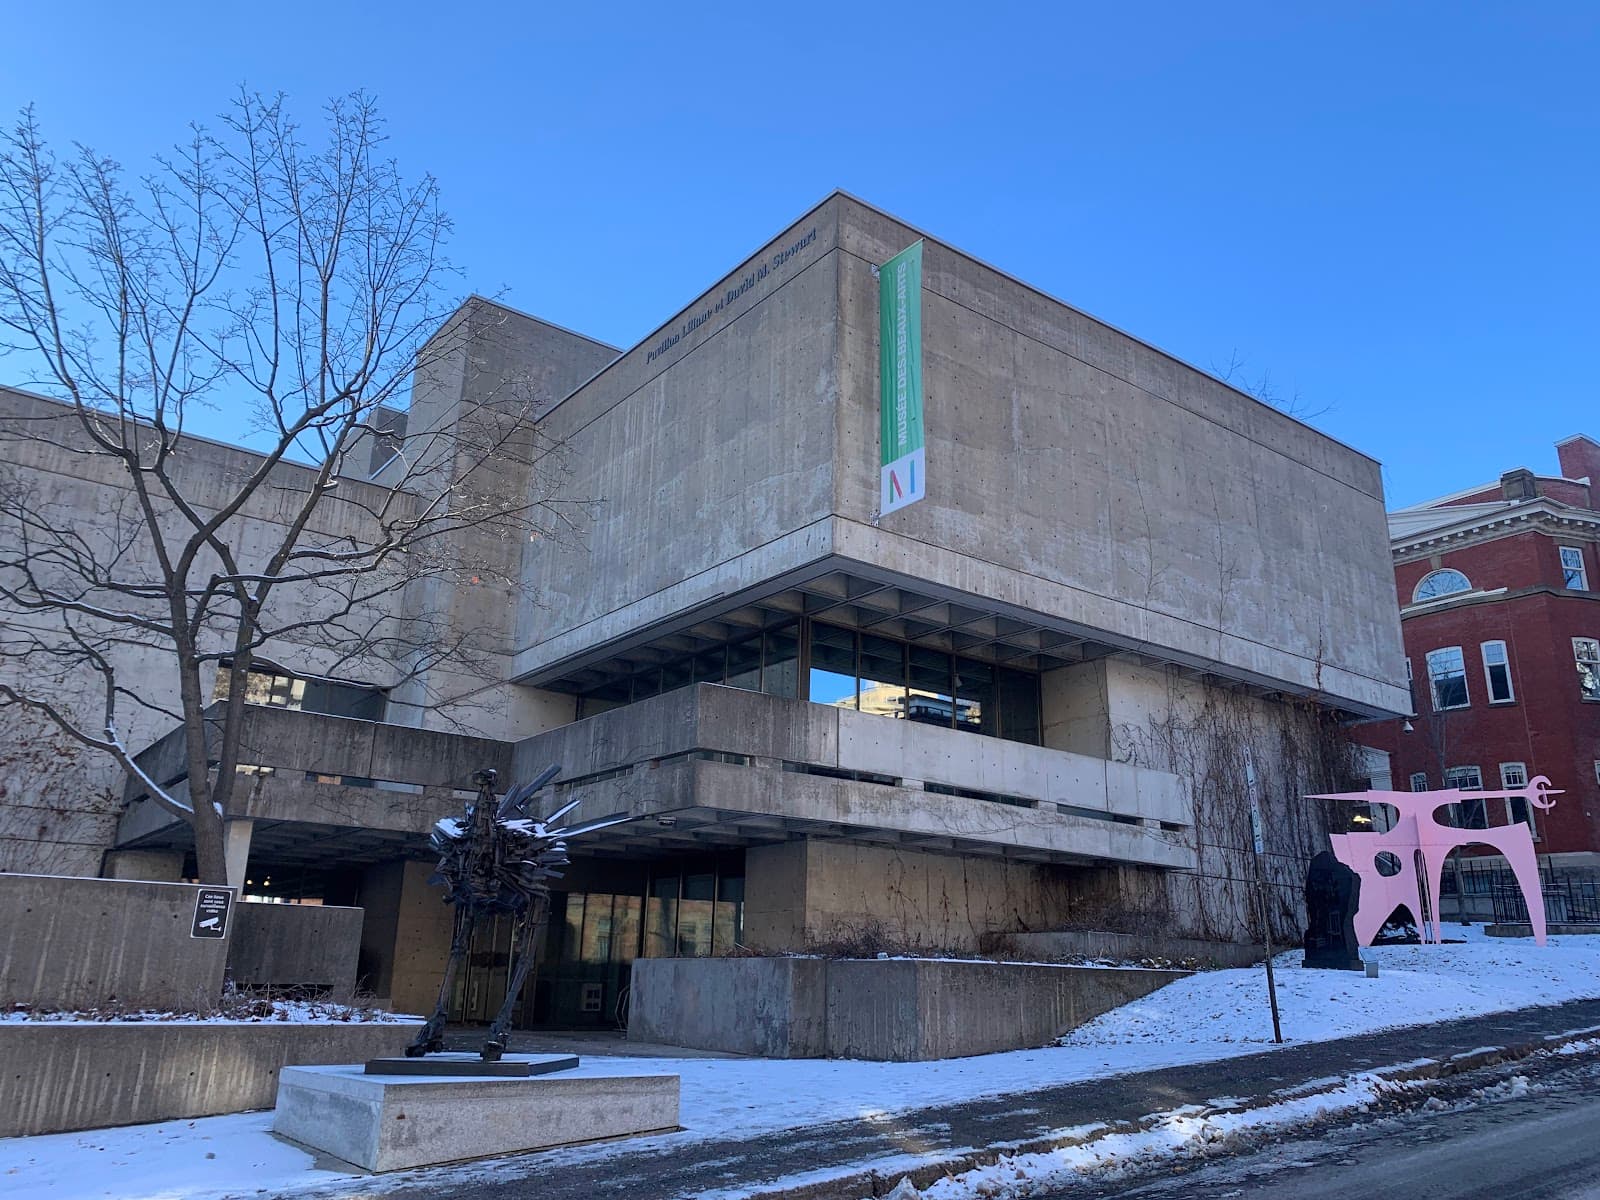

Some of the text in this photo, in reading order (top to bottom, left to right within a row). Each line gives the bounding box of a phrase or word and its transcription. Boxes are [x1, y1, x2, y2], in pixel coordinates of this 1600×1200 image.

[646, 333, 680, 364] Pavillon
[725, 273, 755, 306] David
[772, 227, 817, 270] Stewart
[896, 262, 907, 446] MUSÉE DES BEAUX-ARTS
